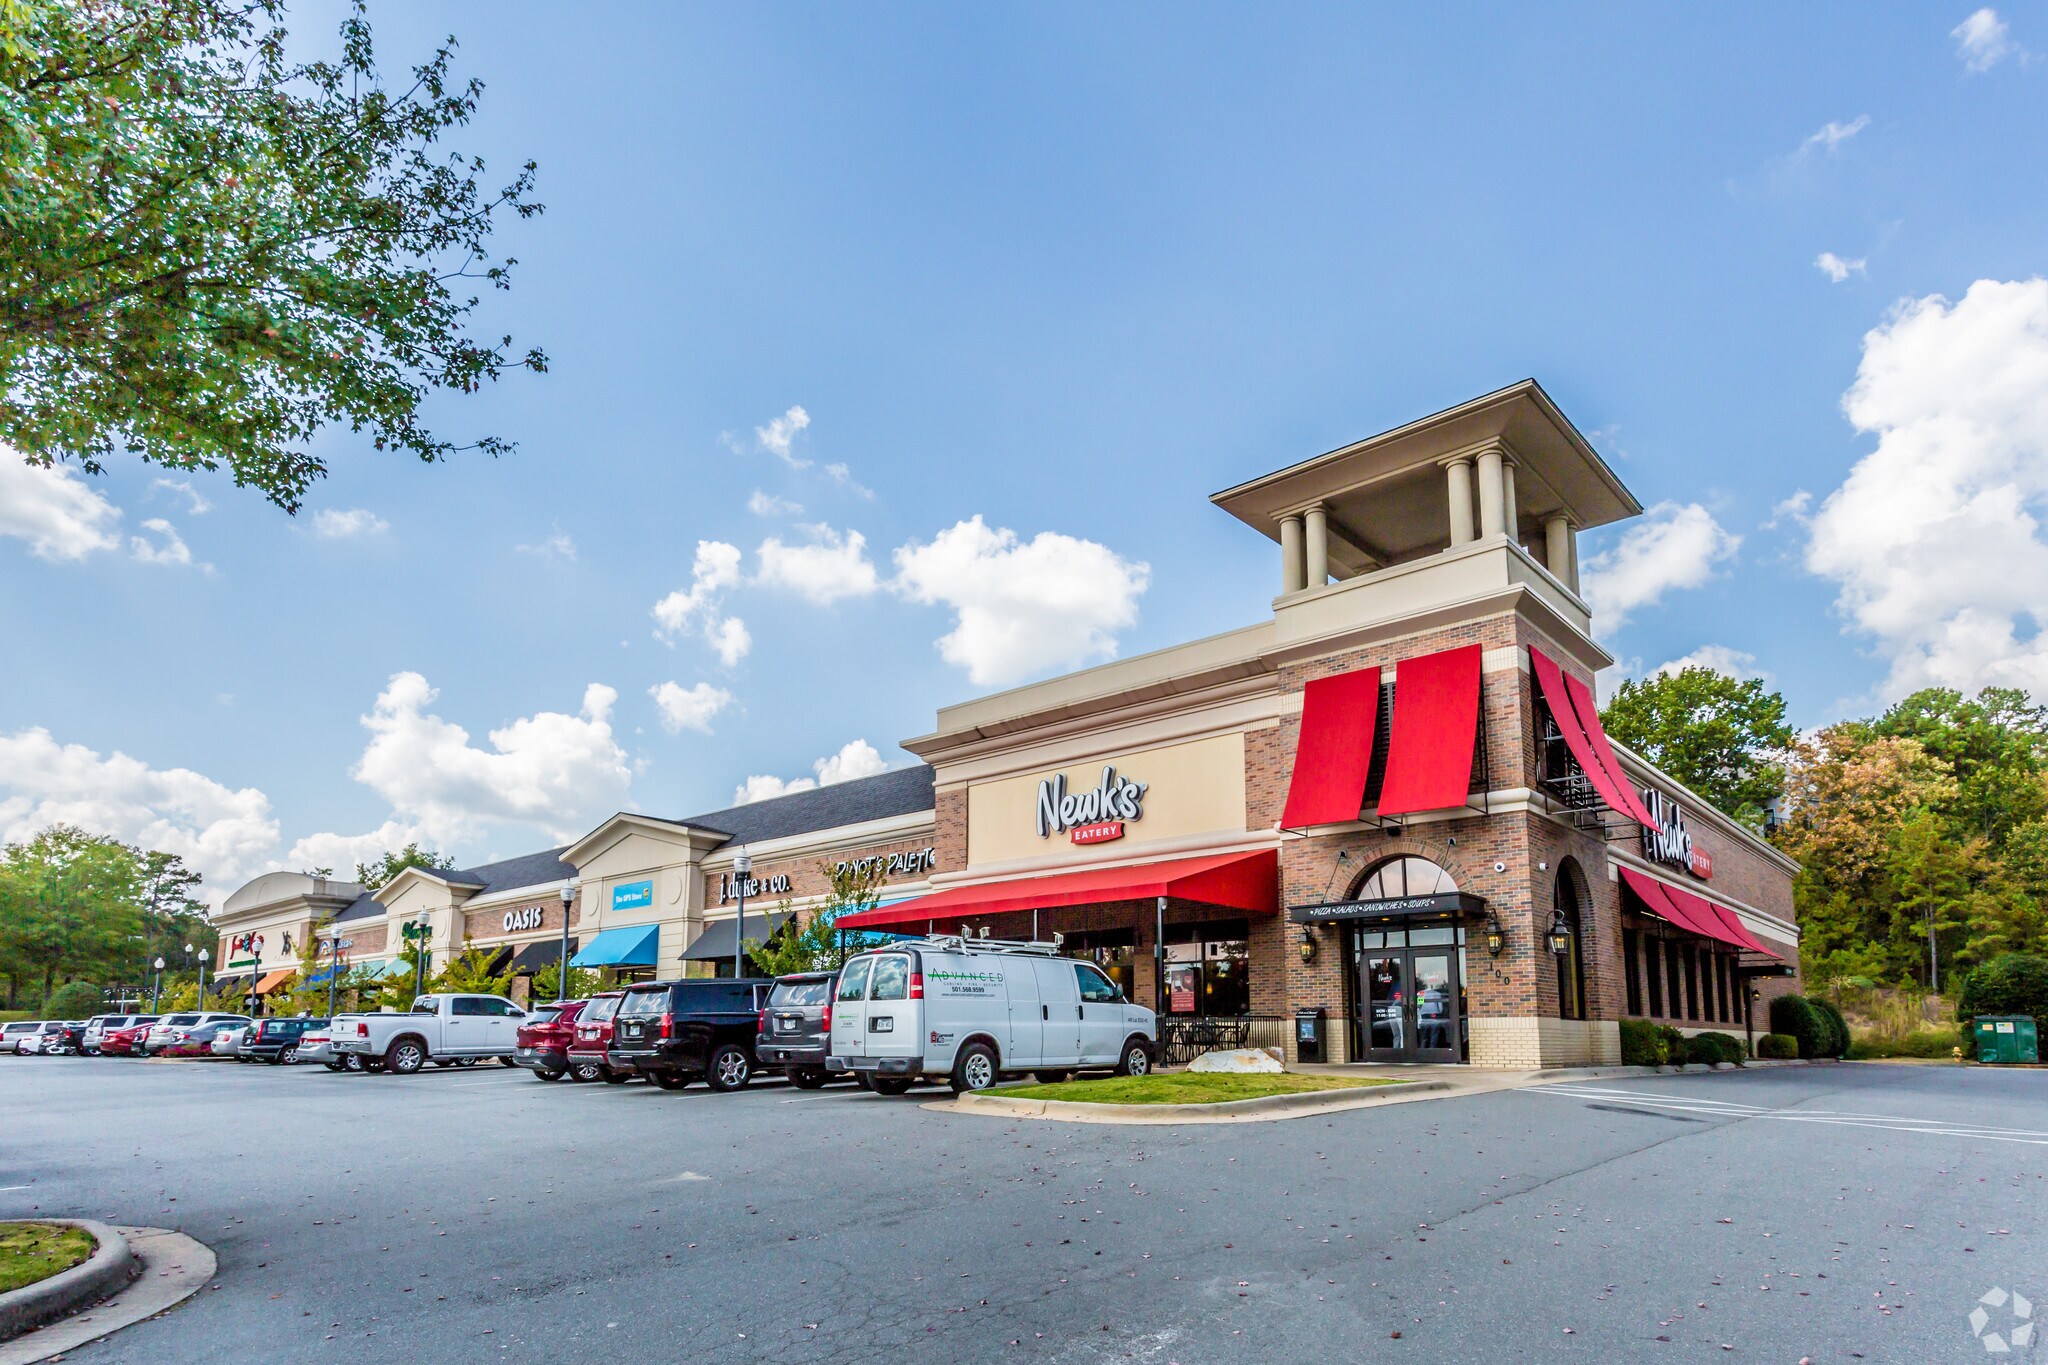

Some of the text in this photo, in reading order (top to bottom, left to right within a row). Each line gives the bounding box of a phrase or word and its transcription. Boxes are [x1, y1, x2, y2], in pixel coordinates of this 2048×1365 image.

[1036, 766, 1143, 839] Newk's
[1074, 825, 1117, 841] EATERY
[1643, 788, 1693, 871] Newk's
[615, 892, 643, 903] The UPS Store
[719, 874, 726, 905] j.
[761, 878, 768, 892] &
[770, 874, 790, 893] co.
[1314, 899, 1431, 916] PIZZA SALADS SANDWICHES SOUPS
[503, 906, 543, 933] OASIS
[931, 968, 1004, 982] ADVANCED
